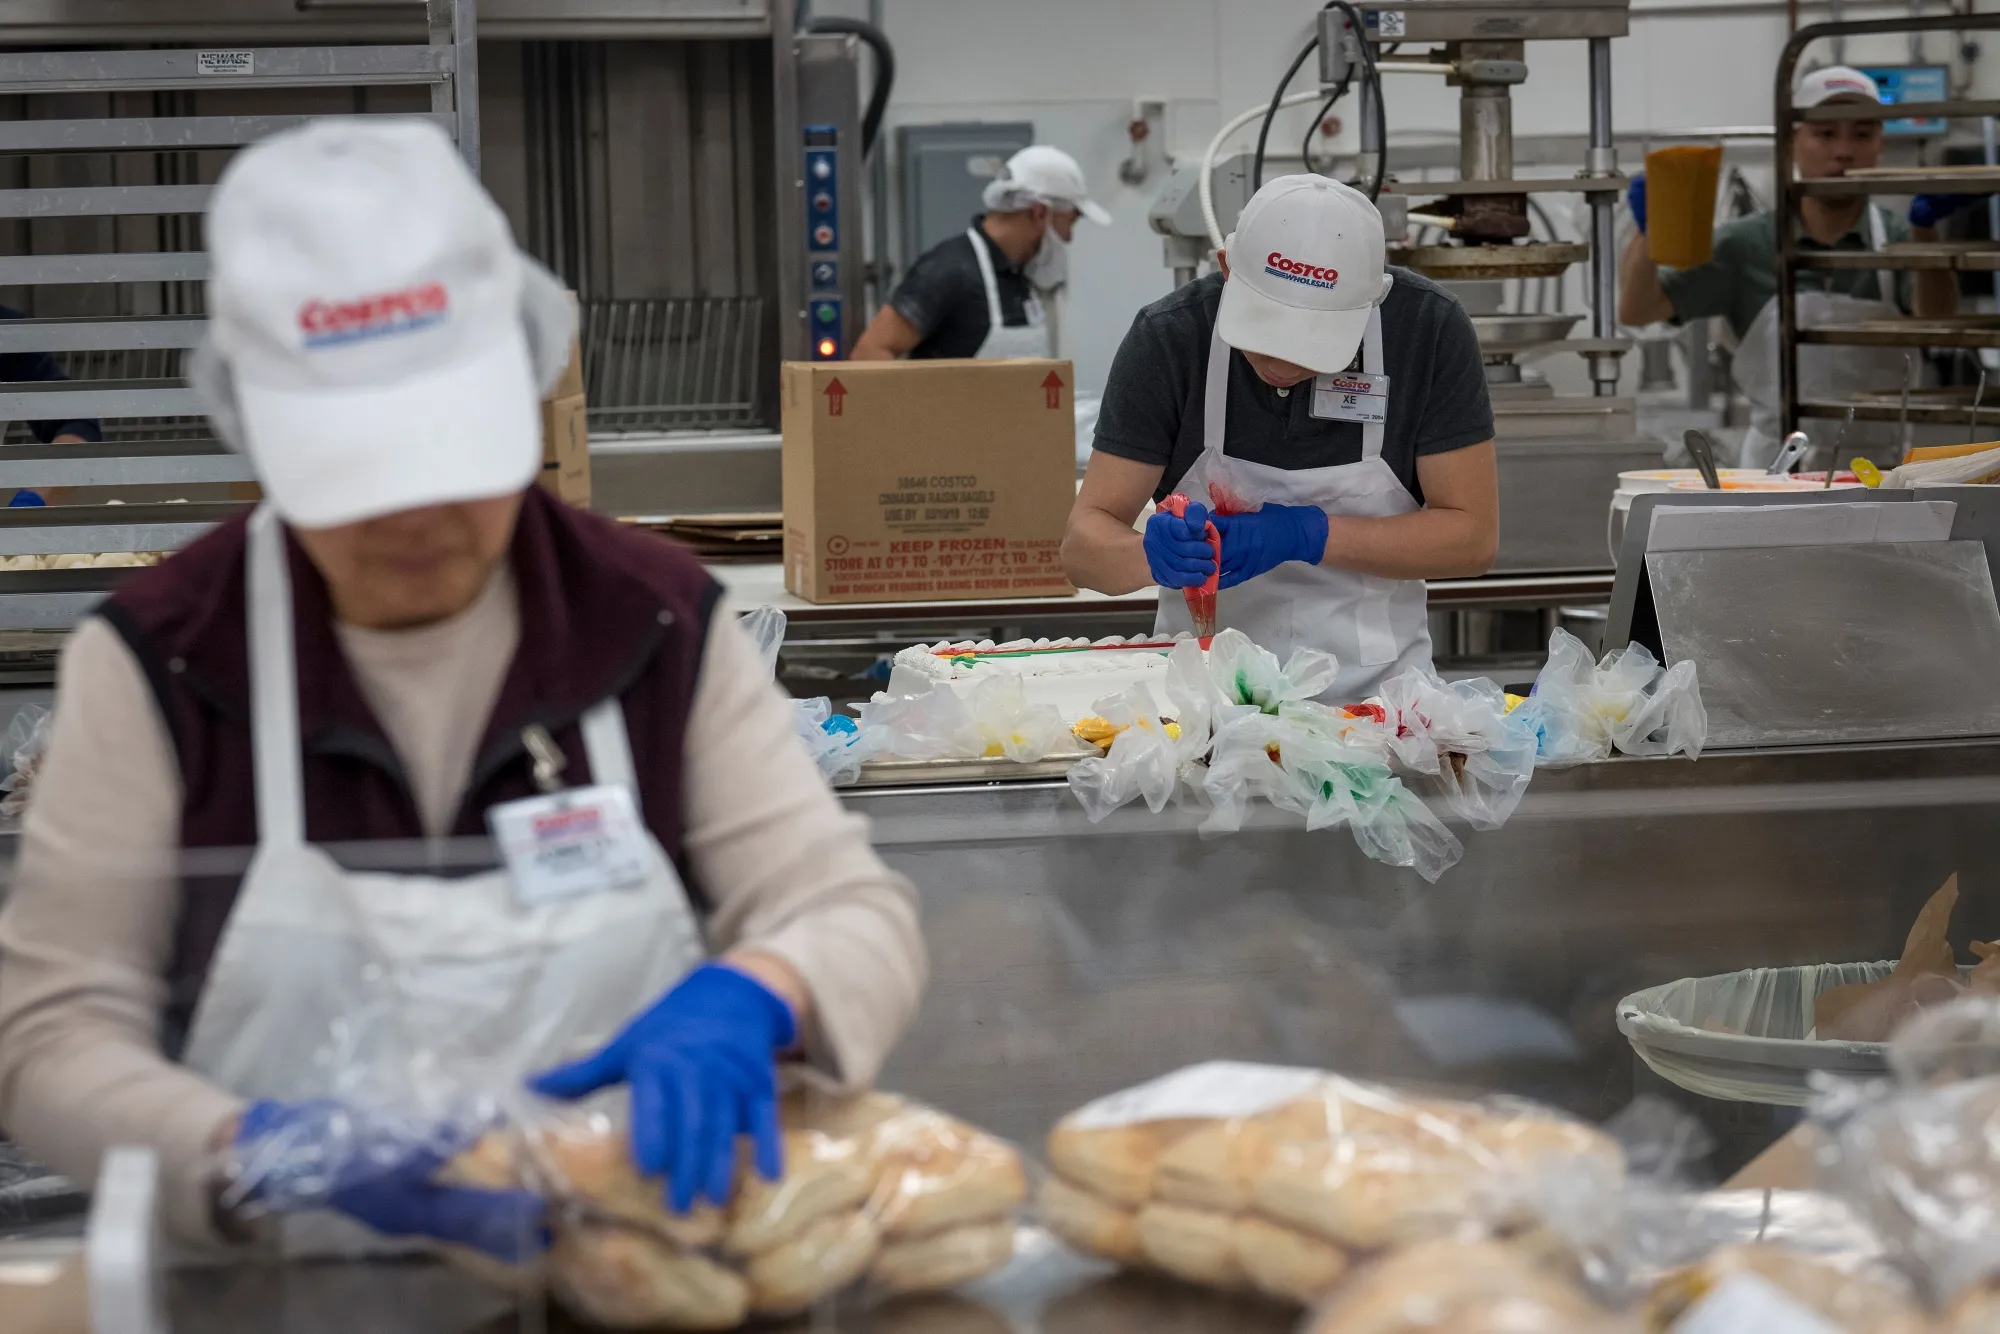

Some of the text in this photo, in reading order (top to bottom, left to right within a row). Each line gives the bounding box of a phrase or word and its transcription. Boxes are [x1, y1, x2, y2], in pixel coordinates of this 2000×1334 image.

[200, 53, 251, 64] NEWAGE
[1285, 272, 1335, 290] WHOLESALE
[1342, 394, 1357, 405] XE
[930, 475, 978, 488] COSTCO
[878, 490, 996, 506] CINNAMON RAISIN BAGELS
[904, 508, 917, 521] BY
[890, 540, 934, 553] KEEP
[939, 537, 1006, 552] FROZEN
[825, 557, 863, 571] STORE
[867, 557, 882, 569] AT
[913, 555, 928, 568] TO
[1012, 551, 1028, 564] TO
[999, 566, 1013, 575] CA
[828, 584, 850, 595] RAW
[853, 583, 885, 594] DOUGH
[888, 581, 933, 593] REQUIRES
[936, 580, 973, 591] BAKING
[974, 578, 1010, 590] BEFORE
